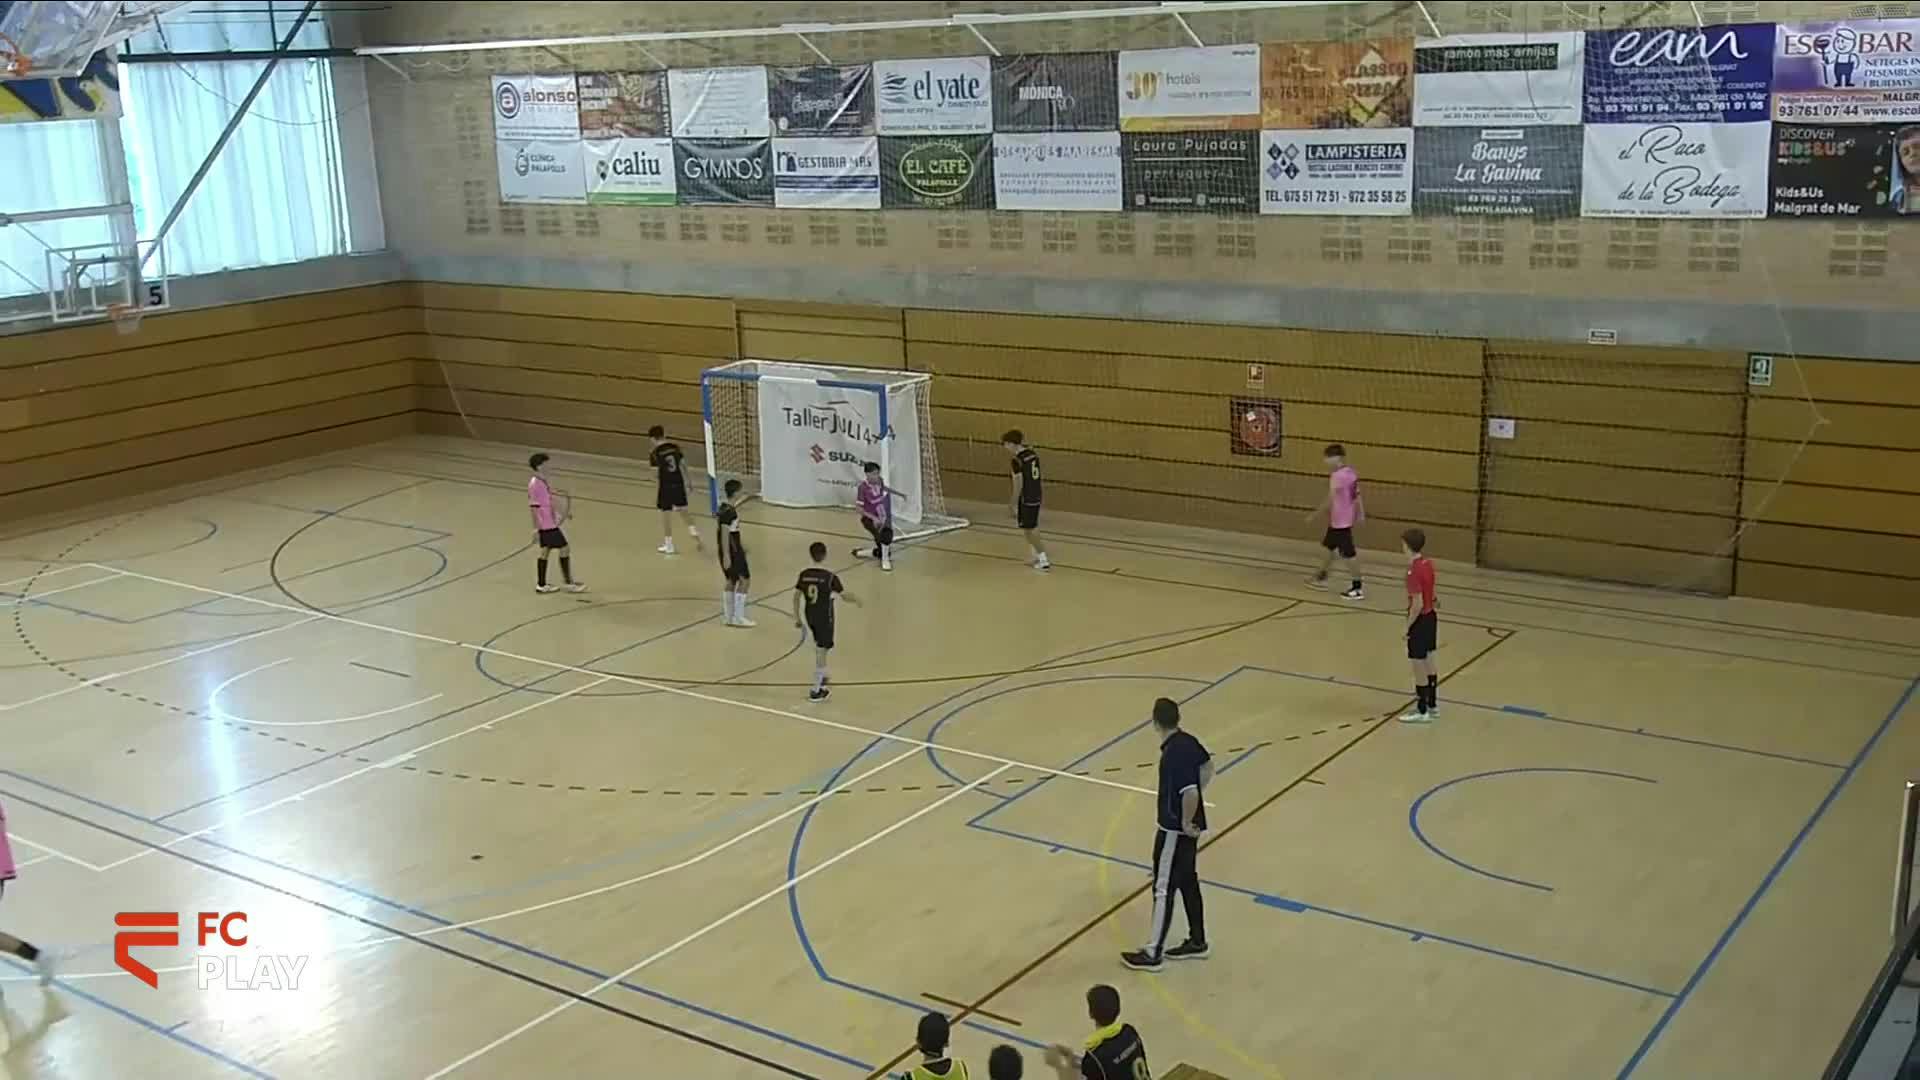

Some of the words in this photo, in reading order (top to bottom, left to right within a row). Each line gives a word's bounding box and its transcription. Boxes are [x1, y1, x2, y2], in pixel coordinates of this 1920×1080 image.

[1609, 29, 1748, 66] eam
[1166, 72, 1201, 85] hotels
[523, 88, 576, 103] alonso
[914, 71, 931, 100] el
[936, 73, 979, 107] yate
[1882, 92, 1920, 101] MALGR
[1620, 104, 1638, 112] 761
[1779, 105, 1793, 116] 93
[1798, 105, 1819, 116] 761
[1824, 105, 1839, 116] 07
[1842, 105, 1858, 115] 44
[1780, 128, 1835, 139] DISCOVER
[1133, 140, 1176, 152] Laura
[1184, 138, 1247, 153] Pujadas
[1308, 144, 1404, 159] LAMPISTERIA
[1472, 141, 1529, 162] Banys
[1618, 140, 1637, 160] el
[1778, 141, 1847, 156] KIDS&US
[613, 151, 661, 176] caliu
[684, 157, 763, 180] GYMNOS
[906, 159, 924, 174] EL
[1454, 163, 1477, 182] La
[1481, 163, 1543, 184] Gavina
[1617, 183, 1635, 201] de
[1638, 182, 1653, 201] la
[1653, 166, 1740, 208] Bodega
[1776, 187, 1824, 199] Kids&Us
[1265, 190, 1281, 202] TEL.
[1302, 189, 1313, 202] 51
[1316, 189, 1328, 202] 72
[1329, 189, 1340, 202] 51
[1349, 190, 1366, 203] 972
[1367, 190, 1380, 203] 35
[1395, 190, 1407, 203] 25
[1775, 202, 1818, 216] Malgrat
[1821, 203, 1836, 214] de
[1838, 202, 1861, 214] Mar
[150, 286, 162, 306] 5
[782, 407, 829, 431] Taller
[829, 413, 861, 441] JULI
[665, 455, 677, 472] 3
[1031, 460, 1040, 480] 6
[808, 584, 818, 604] 9
